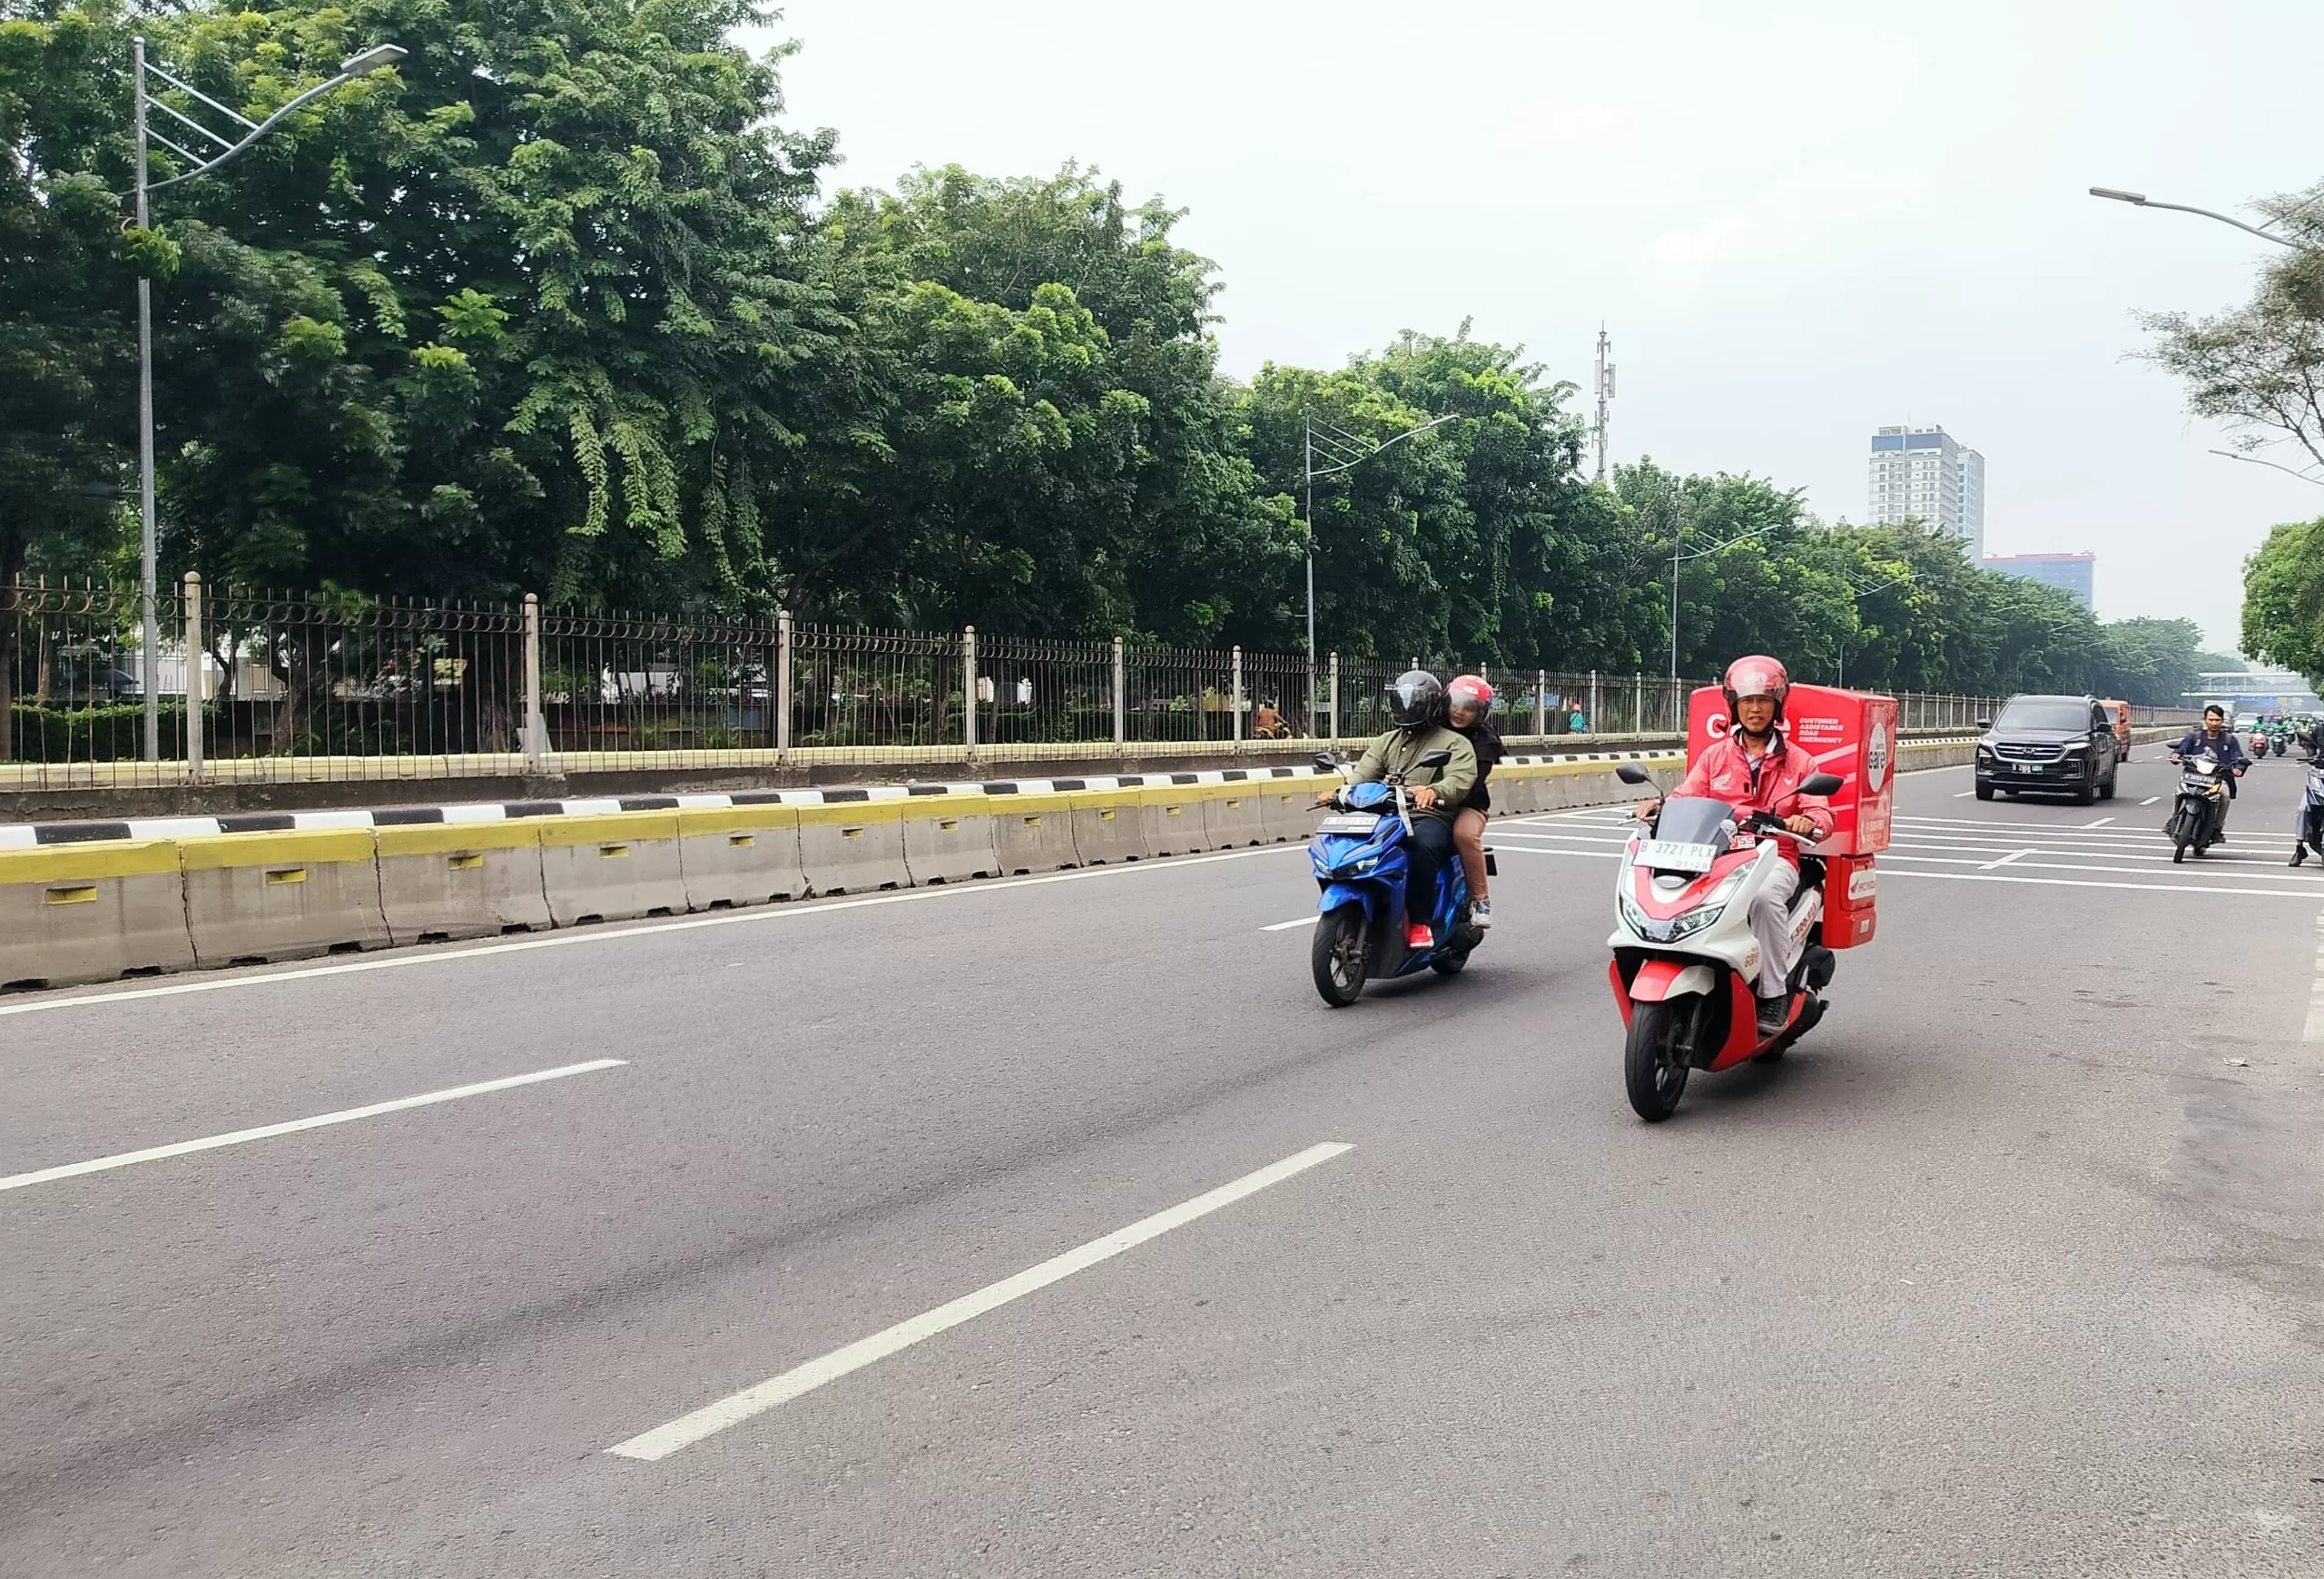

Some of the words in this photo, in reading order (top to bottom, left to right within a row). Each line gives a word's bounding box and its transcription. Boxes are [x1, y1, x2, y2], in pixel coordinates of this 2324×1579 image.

[1640, 842, 1649, 853] B
[1655, 844, 1683, 855] 3721
[1689, 845, 1714, 858] PLX
